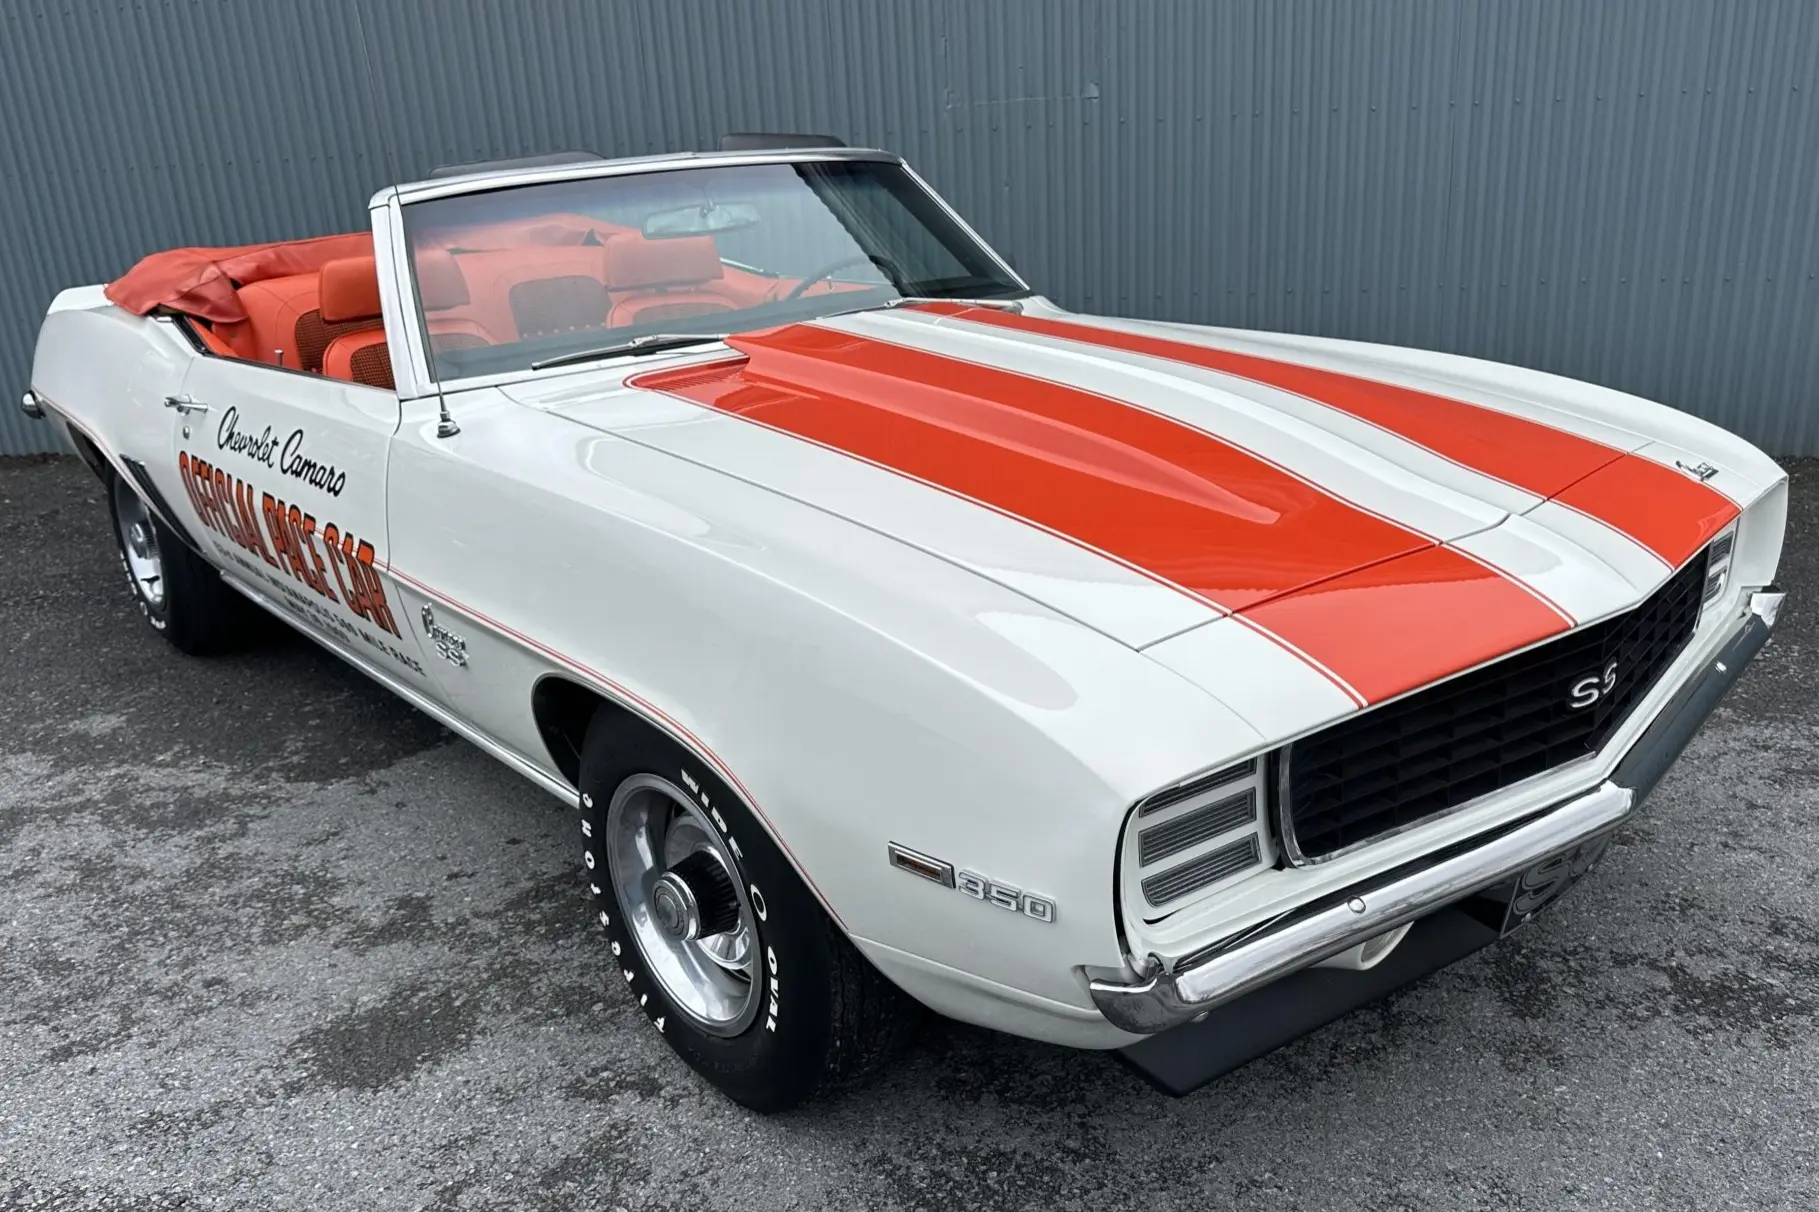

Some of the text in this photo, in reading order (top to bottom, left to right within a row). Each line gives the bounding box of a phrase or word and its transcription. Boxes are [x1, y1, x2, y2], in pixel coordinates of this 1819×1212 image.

[217, 405, 347, 498] Chevrolet Camaro
[178, 449, 278, 566] OFFICIAL
[262, 490, 341, 605] PACE
[322, 521, 403, 641] CAR
[1569, 661, 1618, 709] SS
[680, 768, 744, 861] WIDE
[765, 945, 780, 1033] OVAL
[958, 867, 1057, 923] 350
